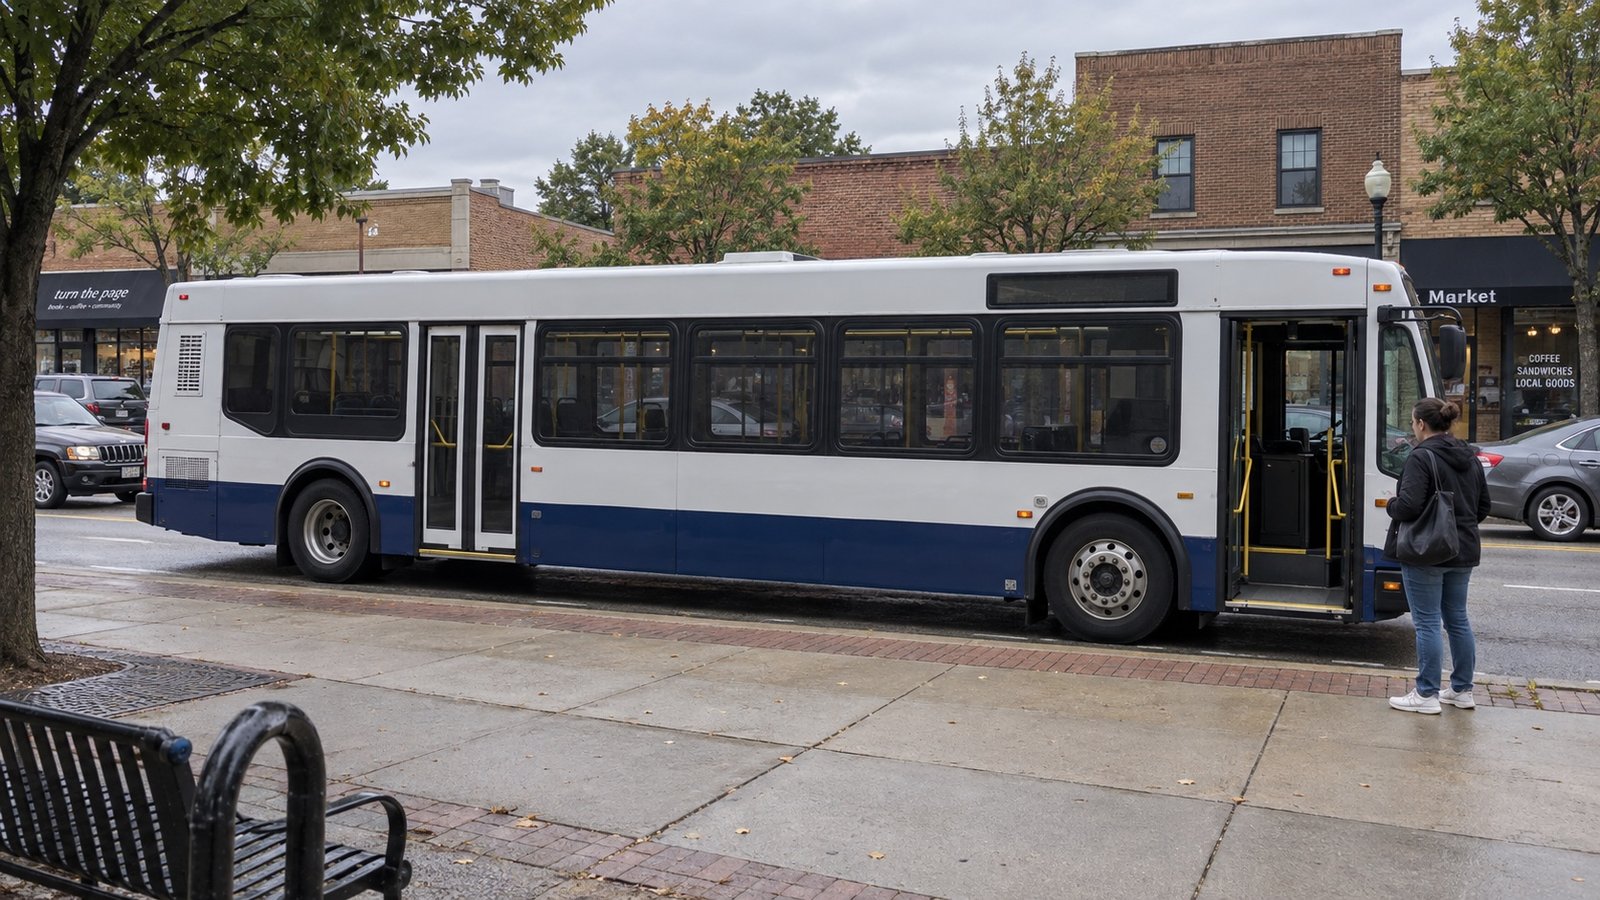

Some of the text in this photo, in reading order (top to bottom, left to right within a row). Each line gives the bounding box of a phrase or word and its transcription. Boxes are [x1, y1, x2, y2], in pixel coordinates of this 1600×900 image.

[54, 287, 129, 301] turn the page
[1428, 289, 1497, 304] Market
[1528, 354, 1561, 363] COFFEE
[1517, 366, 1573, 376] SANDWICHES
[1515, 378, 1576, 388] LOCAL GOODS
